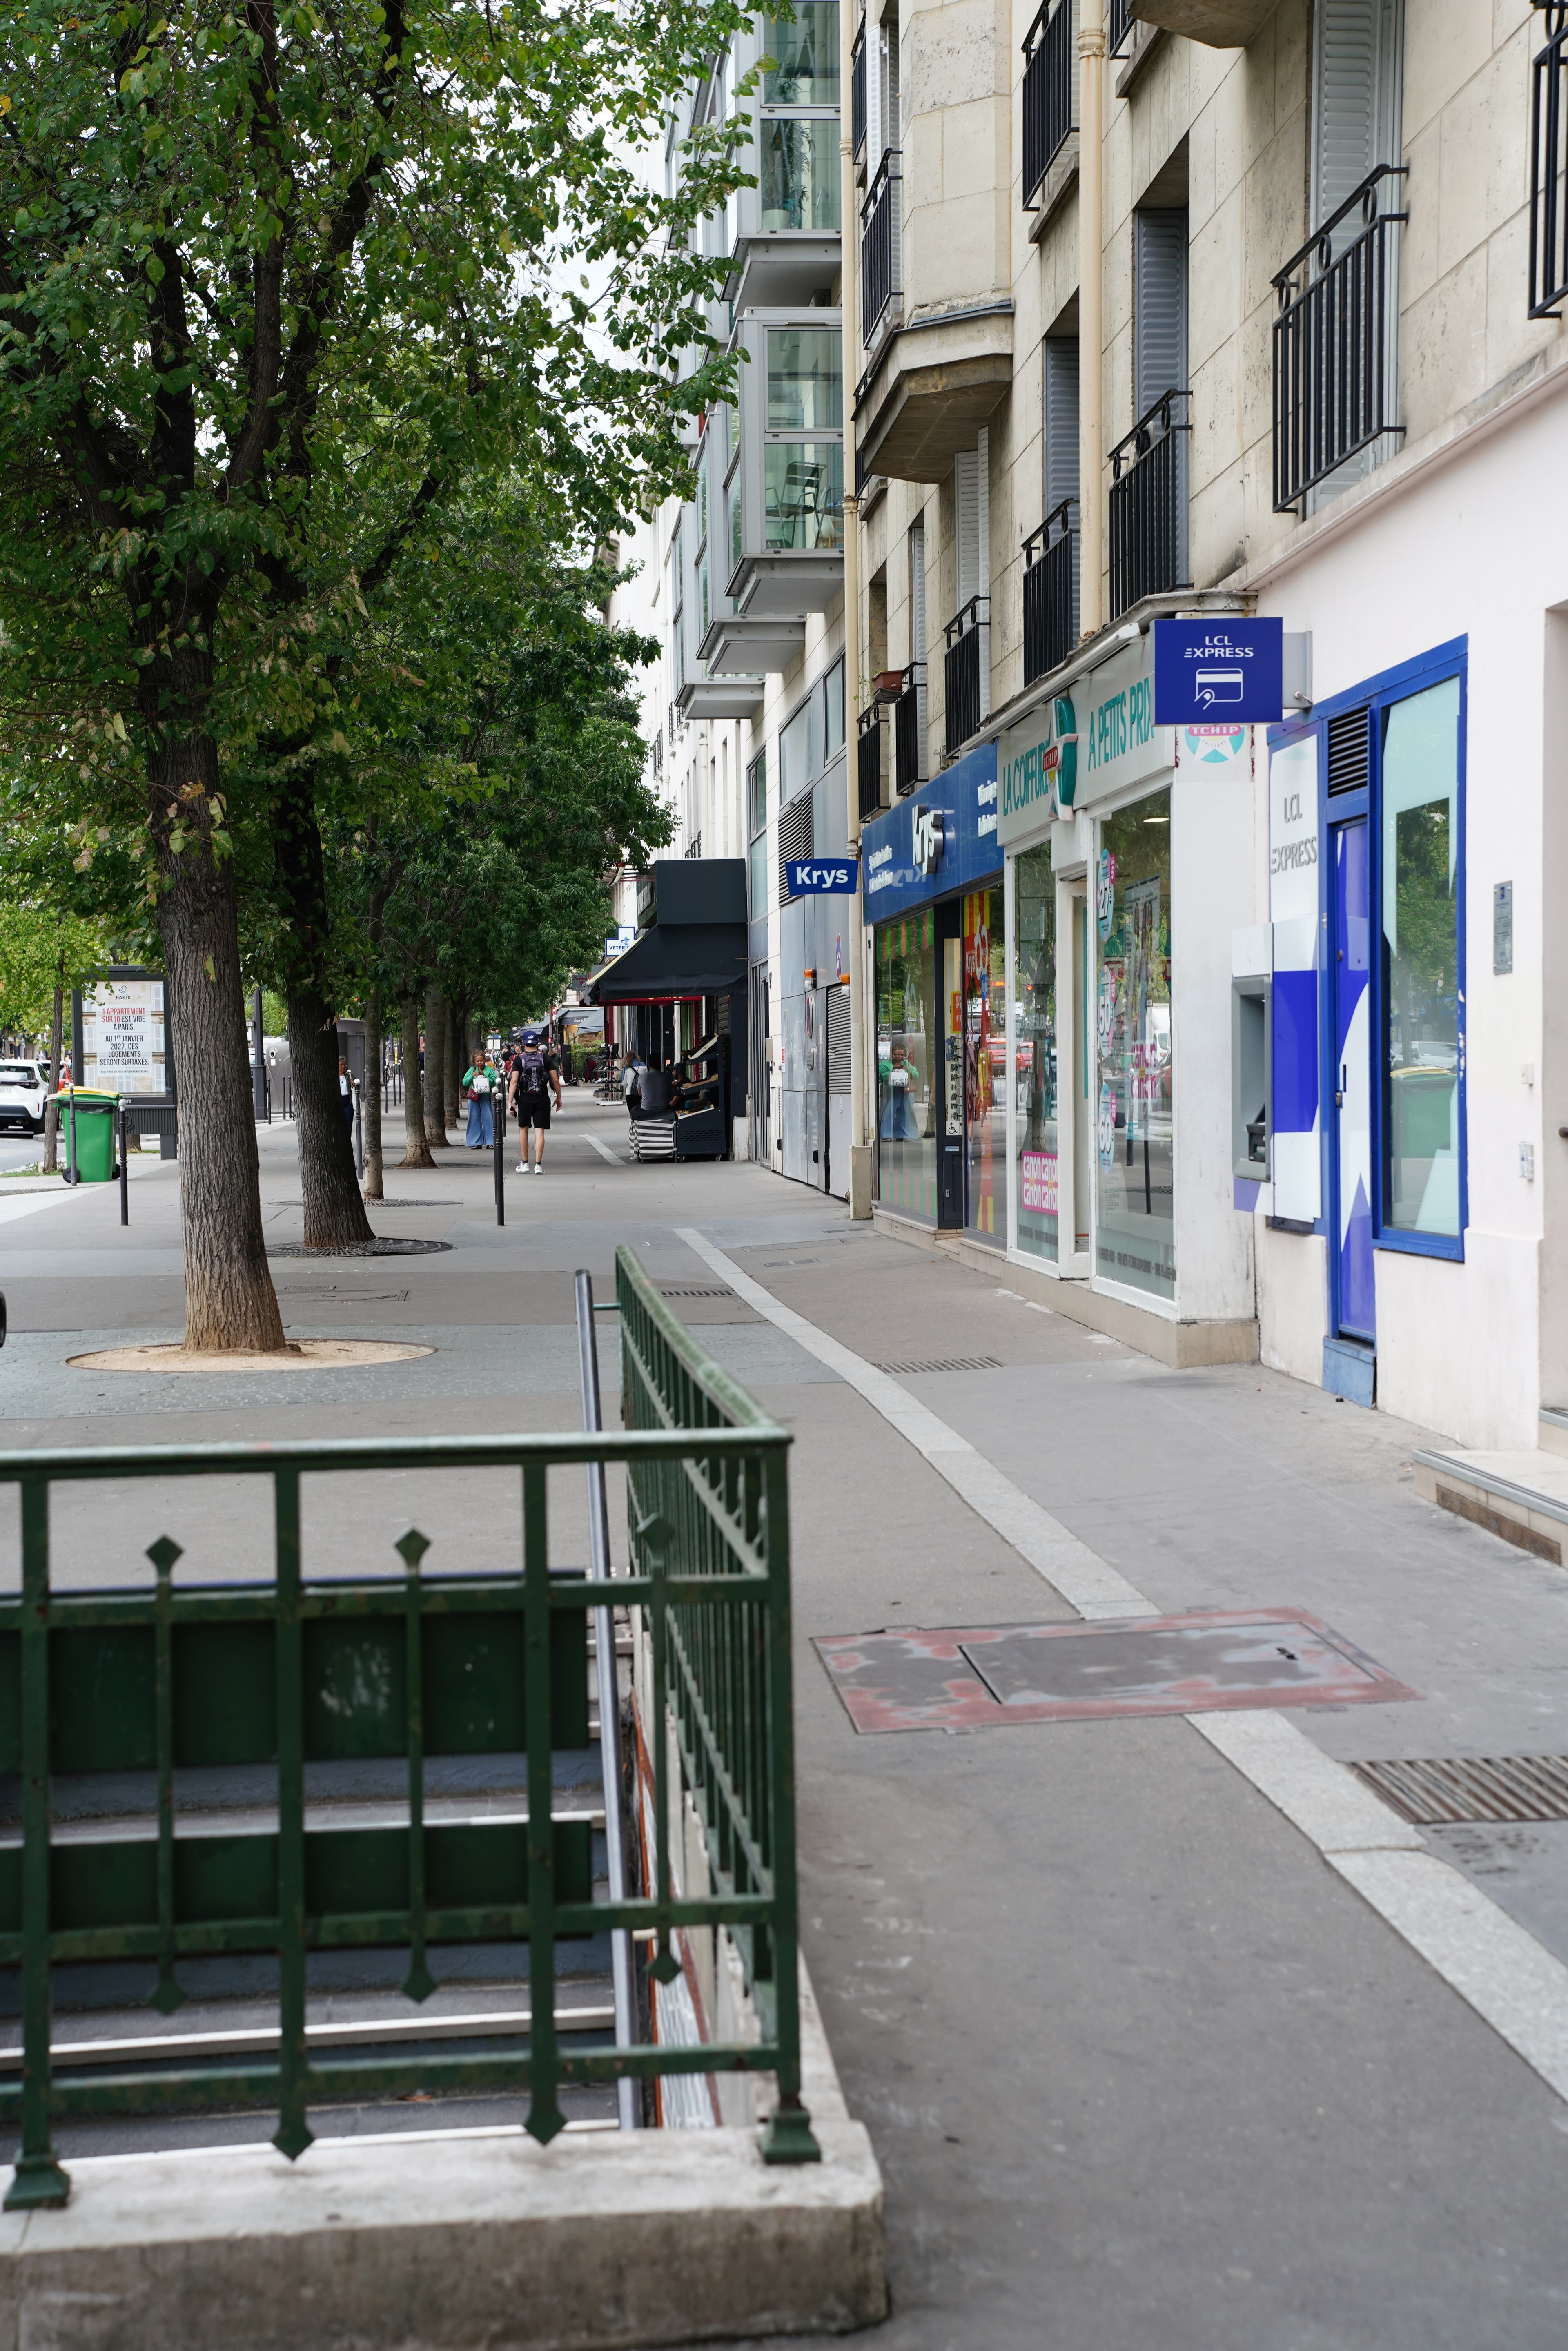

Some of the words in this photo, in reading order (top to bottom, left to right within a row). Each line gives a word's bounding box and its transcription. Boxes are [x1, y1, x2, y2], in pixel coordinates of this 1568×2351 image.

[1184, 647, 1254, 658] EXPRESS
[1205, 636, 1232, 646] LCL
[1098, 690, 1127, 767] PETITS
[1191, 726, 1239, 735] TCHIP
[1043, 749, 1058, 770] TCHIP
[1003, 763, 1012, 817] LA
[1284, 793, 1302, 822] LCL
[912, 804, 941, 875] Krys
[1270, 836, 1317, 874] EXPRESS
[796, 866, 848, 888] Krys
[966, 951, 975, 977] Krys
[121, 1057, 149, 1065] SURTAXÉS.
[1023, 1155, 1041, 1180] canon
[1023, 1182, 1041, 1208] canon
